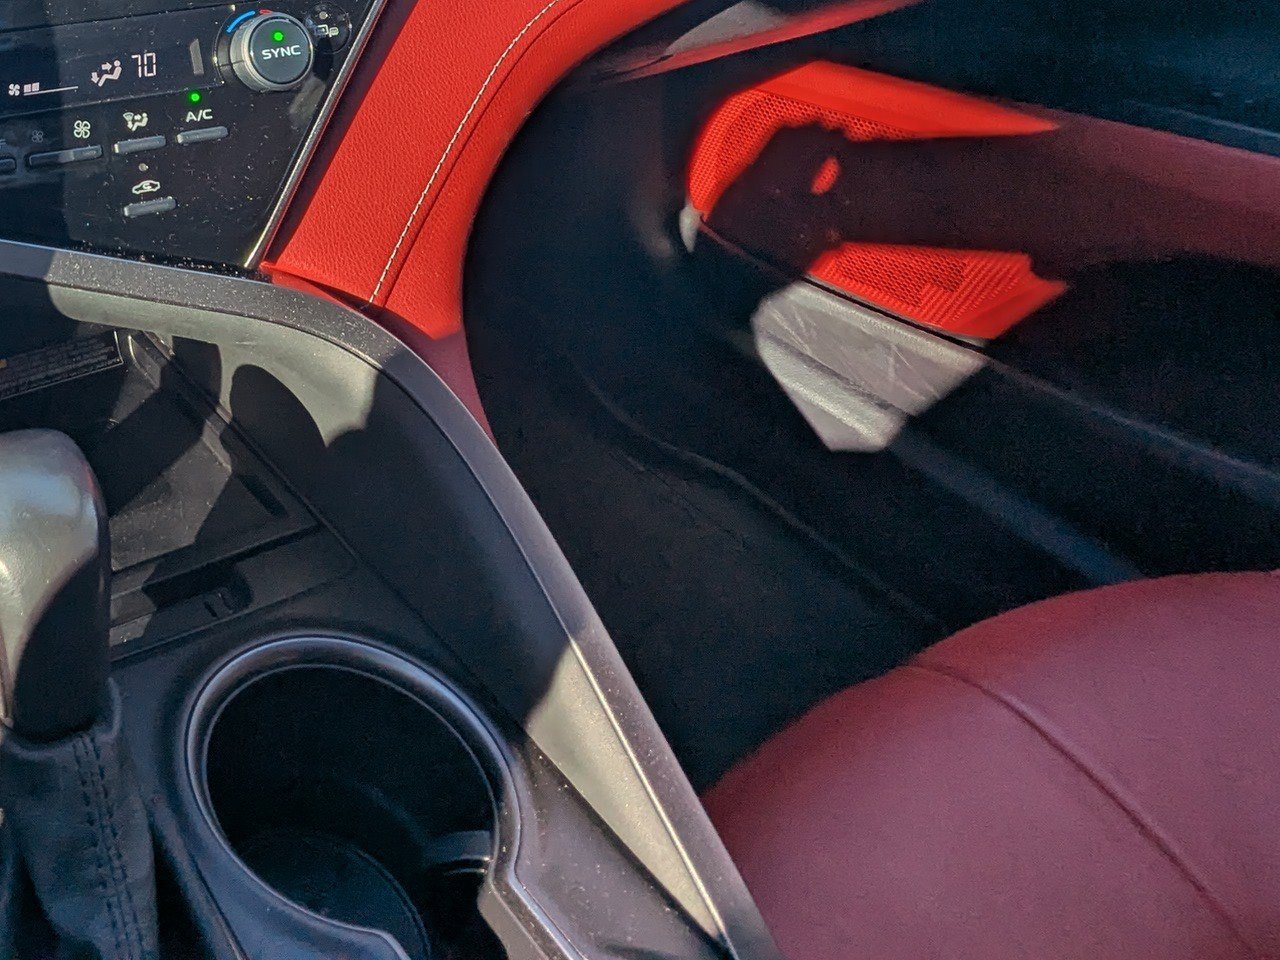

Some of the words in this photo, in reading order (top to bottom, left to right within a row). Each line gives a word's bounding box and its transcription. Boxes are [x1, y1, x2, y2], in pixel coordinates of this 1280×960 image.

[261, 44, 302, 60] SYNC
[131, 52, 157, 78] 70
[185, 108, 214, 123] A/C
